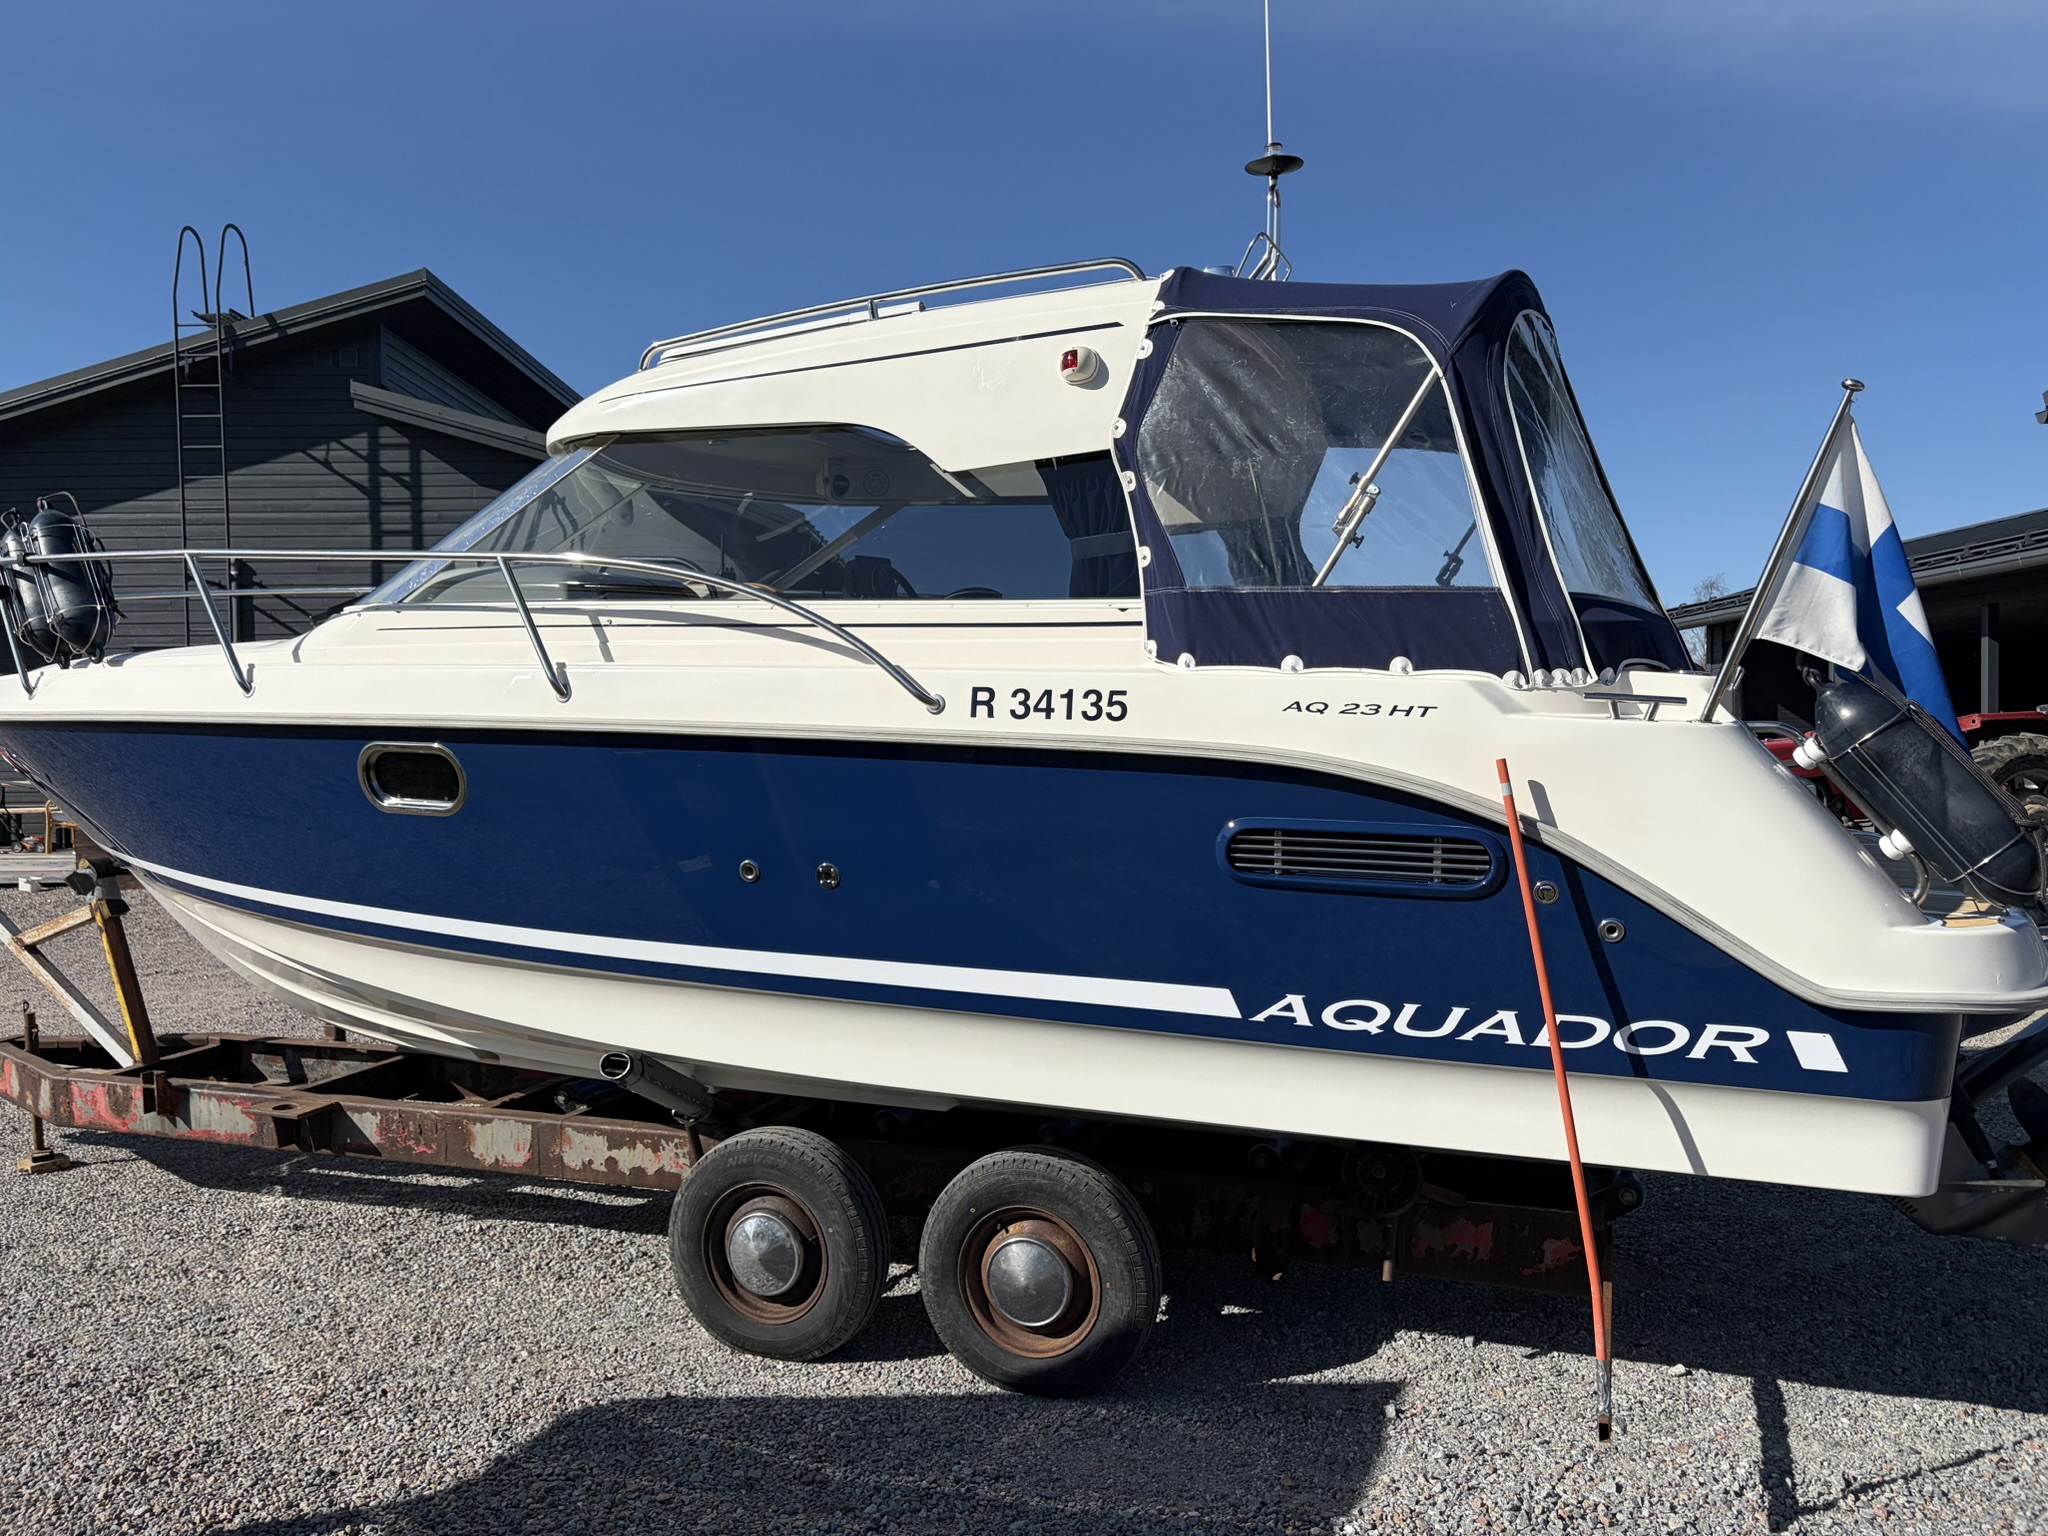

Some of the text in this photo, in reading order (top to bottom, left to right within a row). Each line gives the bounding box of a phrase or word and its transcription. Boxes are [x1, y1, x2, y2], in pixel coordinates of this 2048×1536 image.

[970, 686, 1128, 722] R 34135
[1281, 700, 1439, 718] AQ 23 HT
[1248, 993, 1770, 1064] AQUADOR
